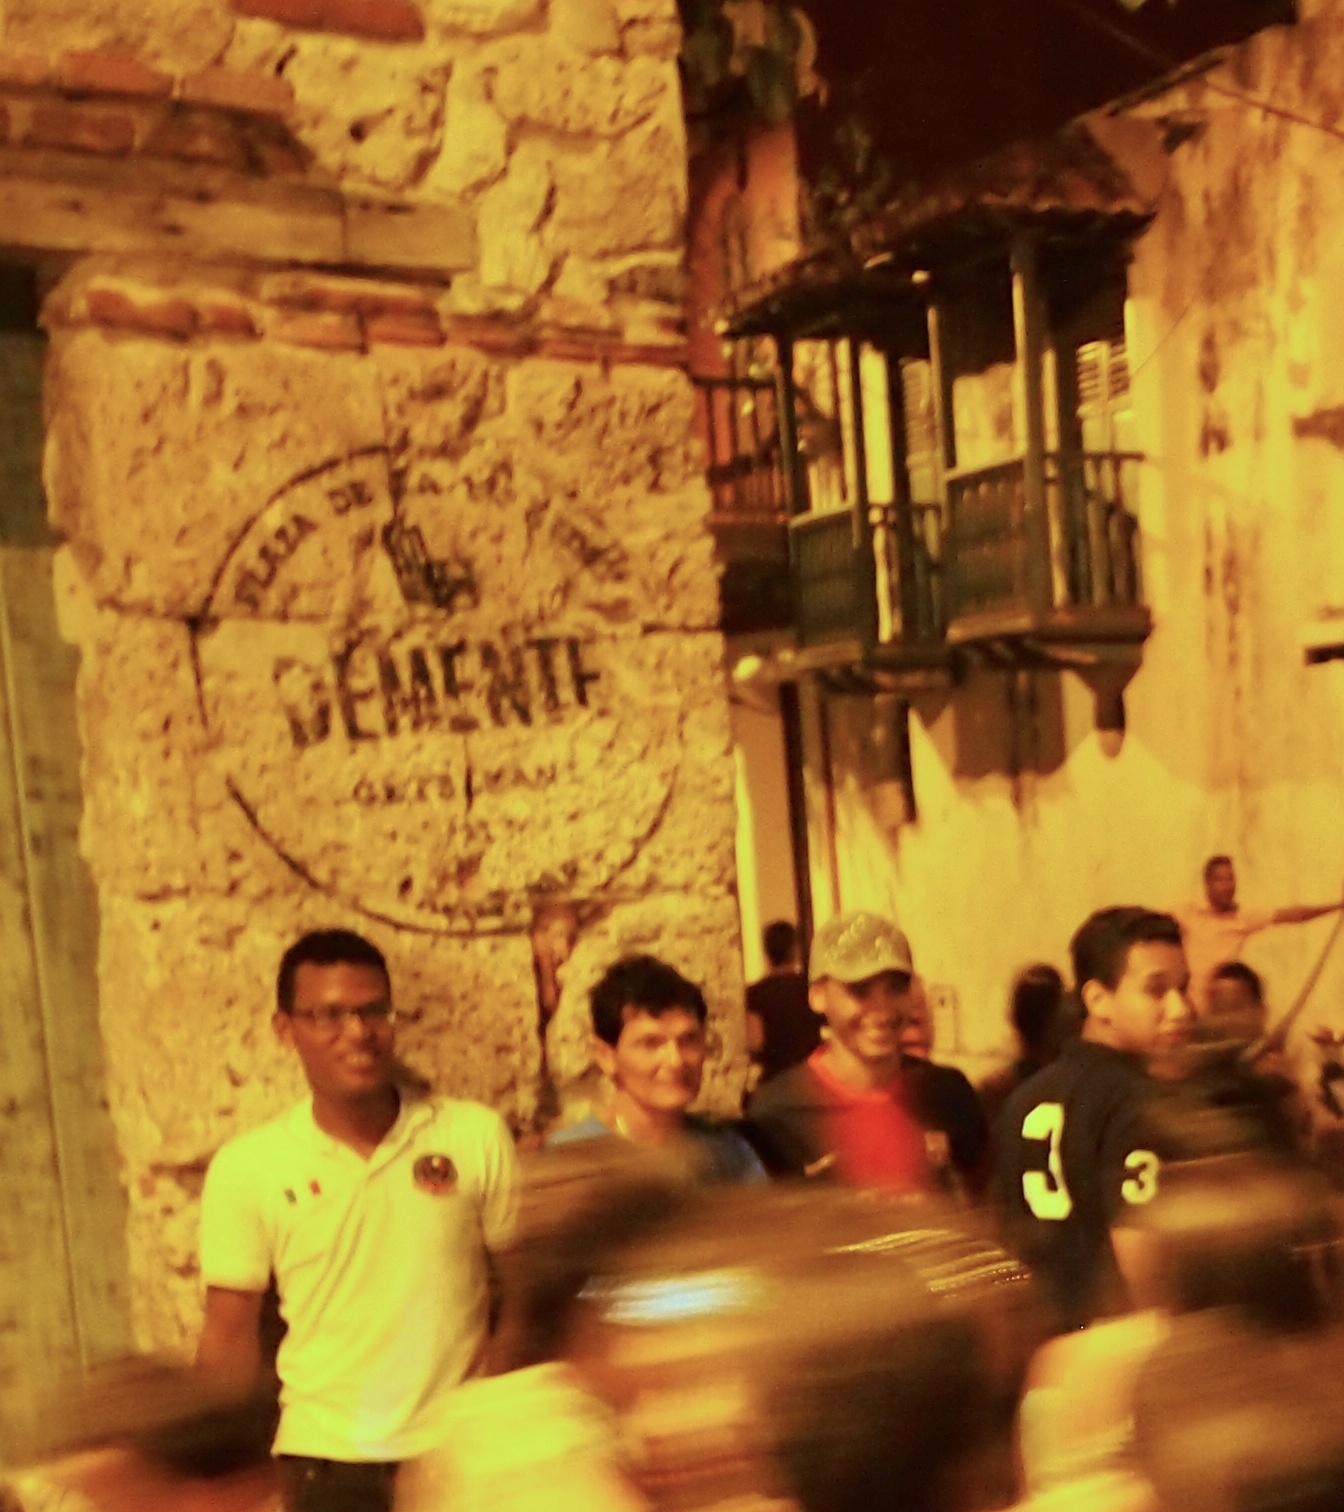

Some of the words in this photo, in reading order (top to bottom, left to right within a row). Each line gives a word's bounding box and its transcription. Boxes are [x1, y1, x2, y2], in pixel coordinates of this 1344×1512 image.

[233, 514, 320, 613] PLAZA
[326, 480, 373, 516] DE
[272, 637, 600, 748] DEMENTE
[1121, 1149, 1160, 1205] 3
